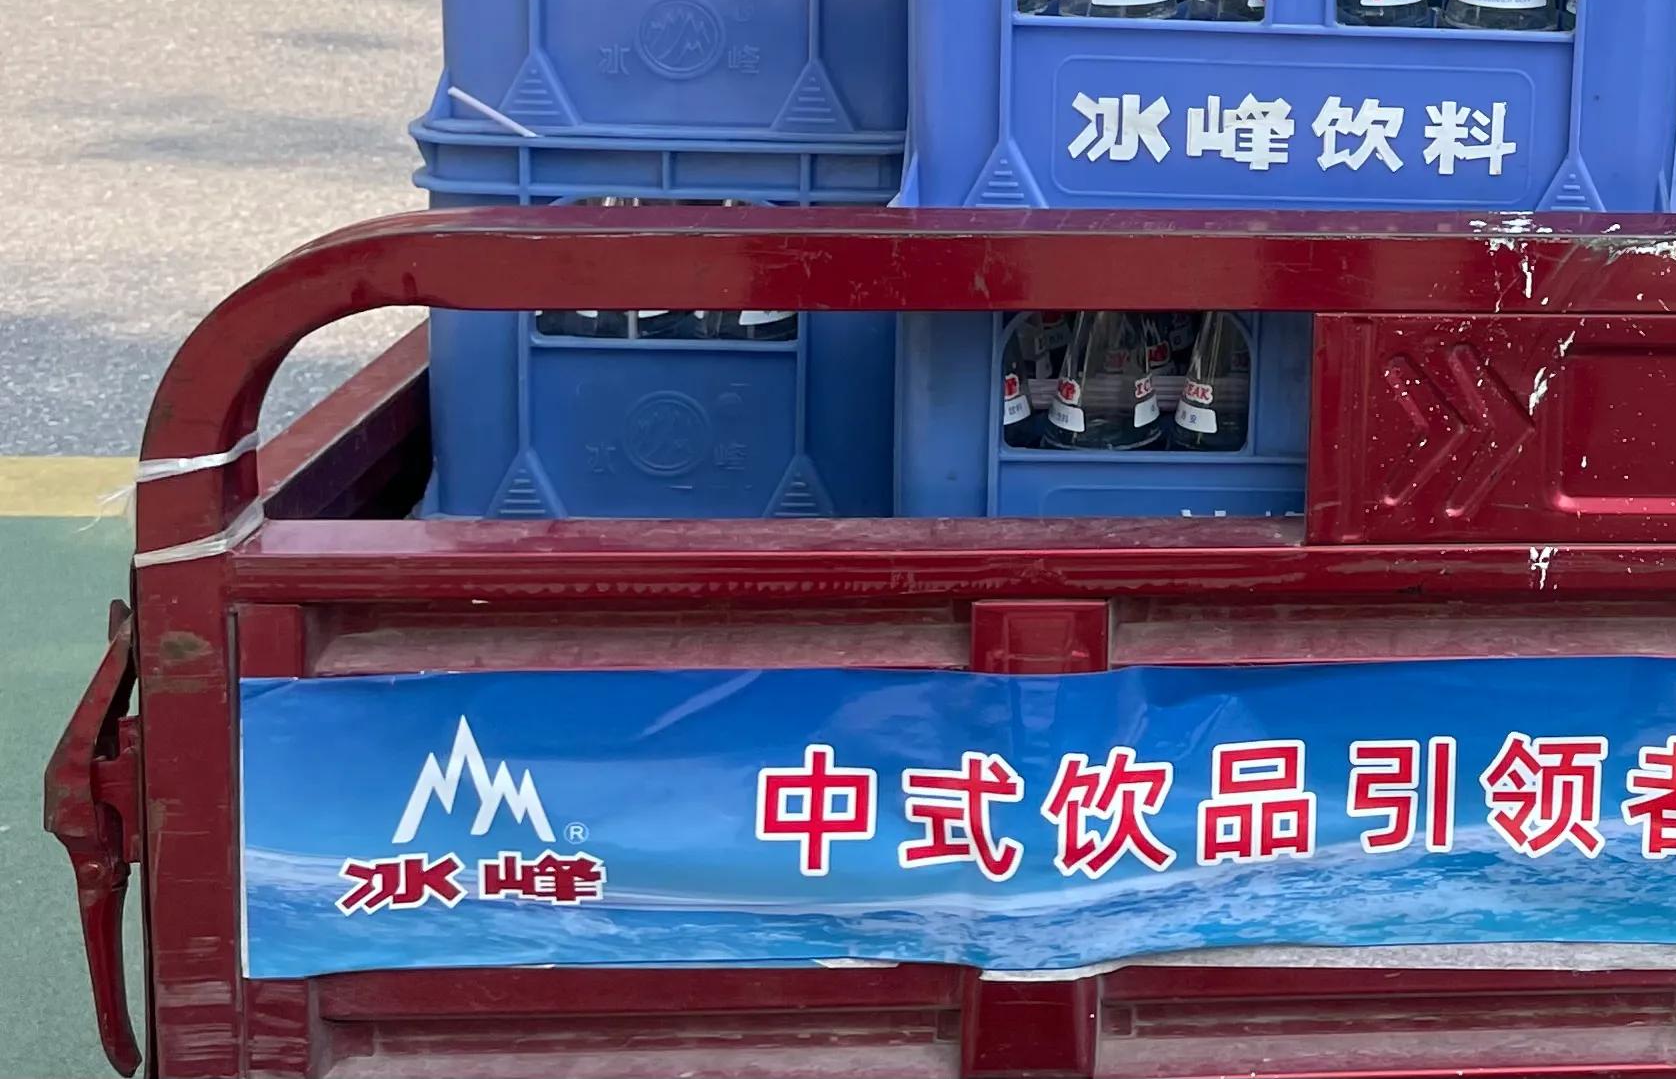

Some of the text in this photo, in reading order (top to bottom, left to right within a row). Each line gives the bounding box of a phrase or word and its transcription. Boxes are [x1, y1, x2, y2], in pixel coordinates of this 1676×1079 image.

[1067, 91, 1517, 175] 冰峰饮料
[335, 849, 608, 915] 冰峰
